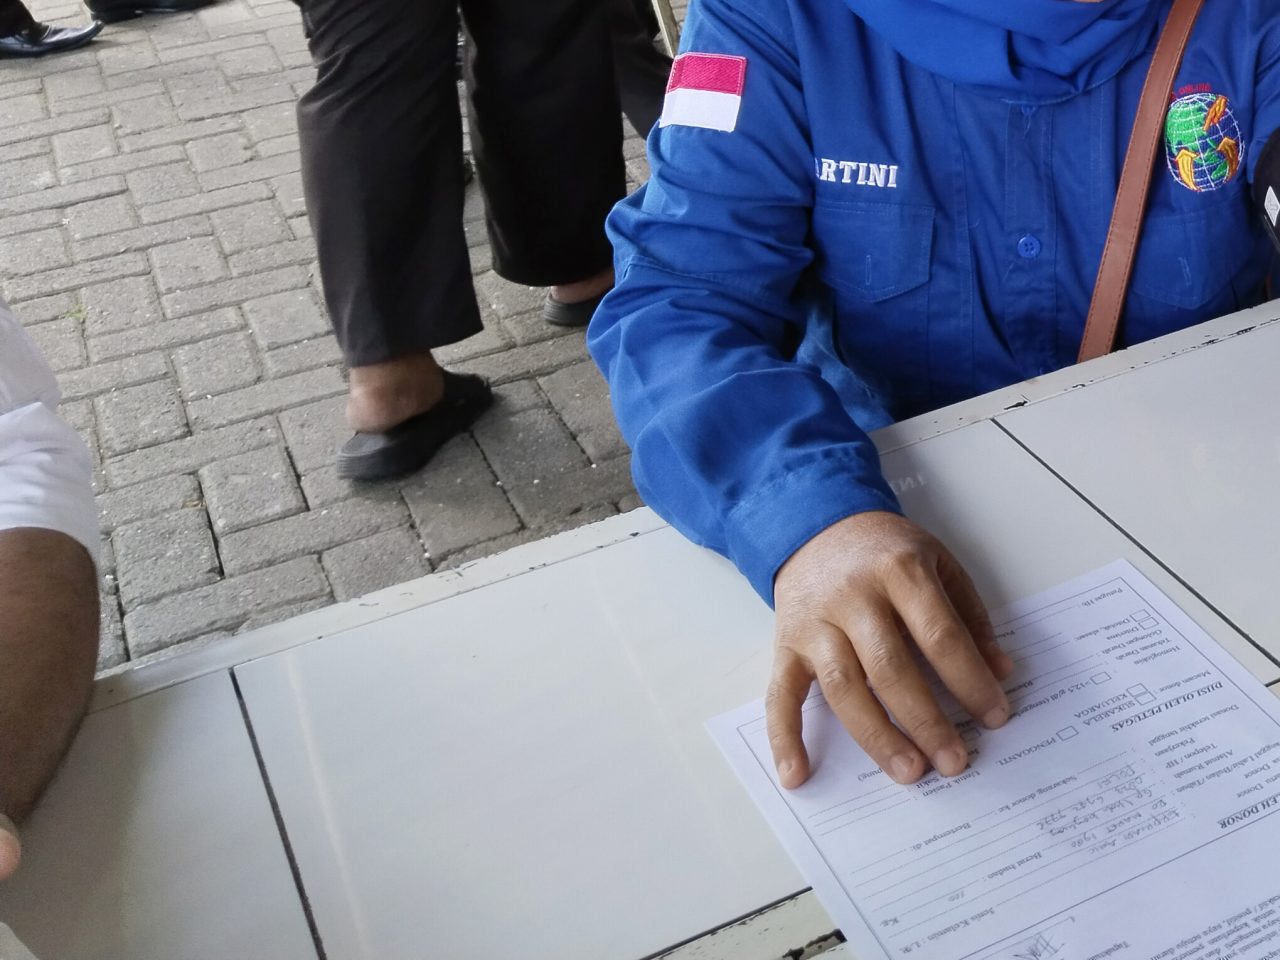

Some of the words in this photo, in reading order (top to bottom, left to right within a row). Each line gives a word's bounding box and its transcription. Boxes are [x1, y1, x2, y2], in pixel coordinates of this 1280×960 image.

[815, 157, 898, 188] RTINI
[1164, 693, 1194, 710] OLEH
[1111, 705, 1162, 732] PETUGAS
[1217, 805, 1259, 829] DONOR
